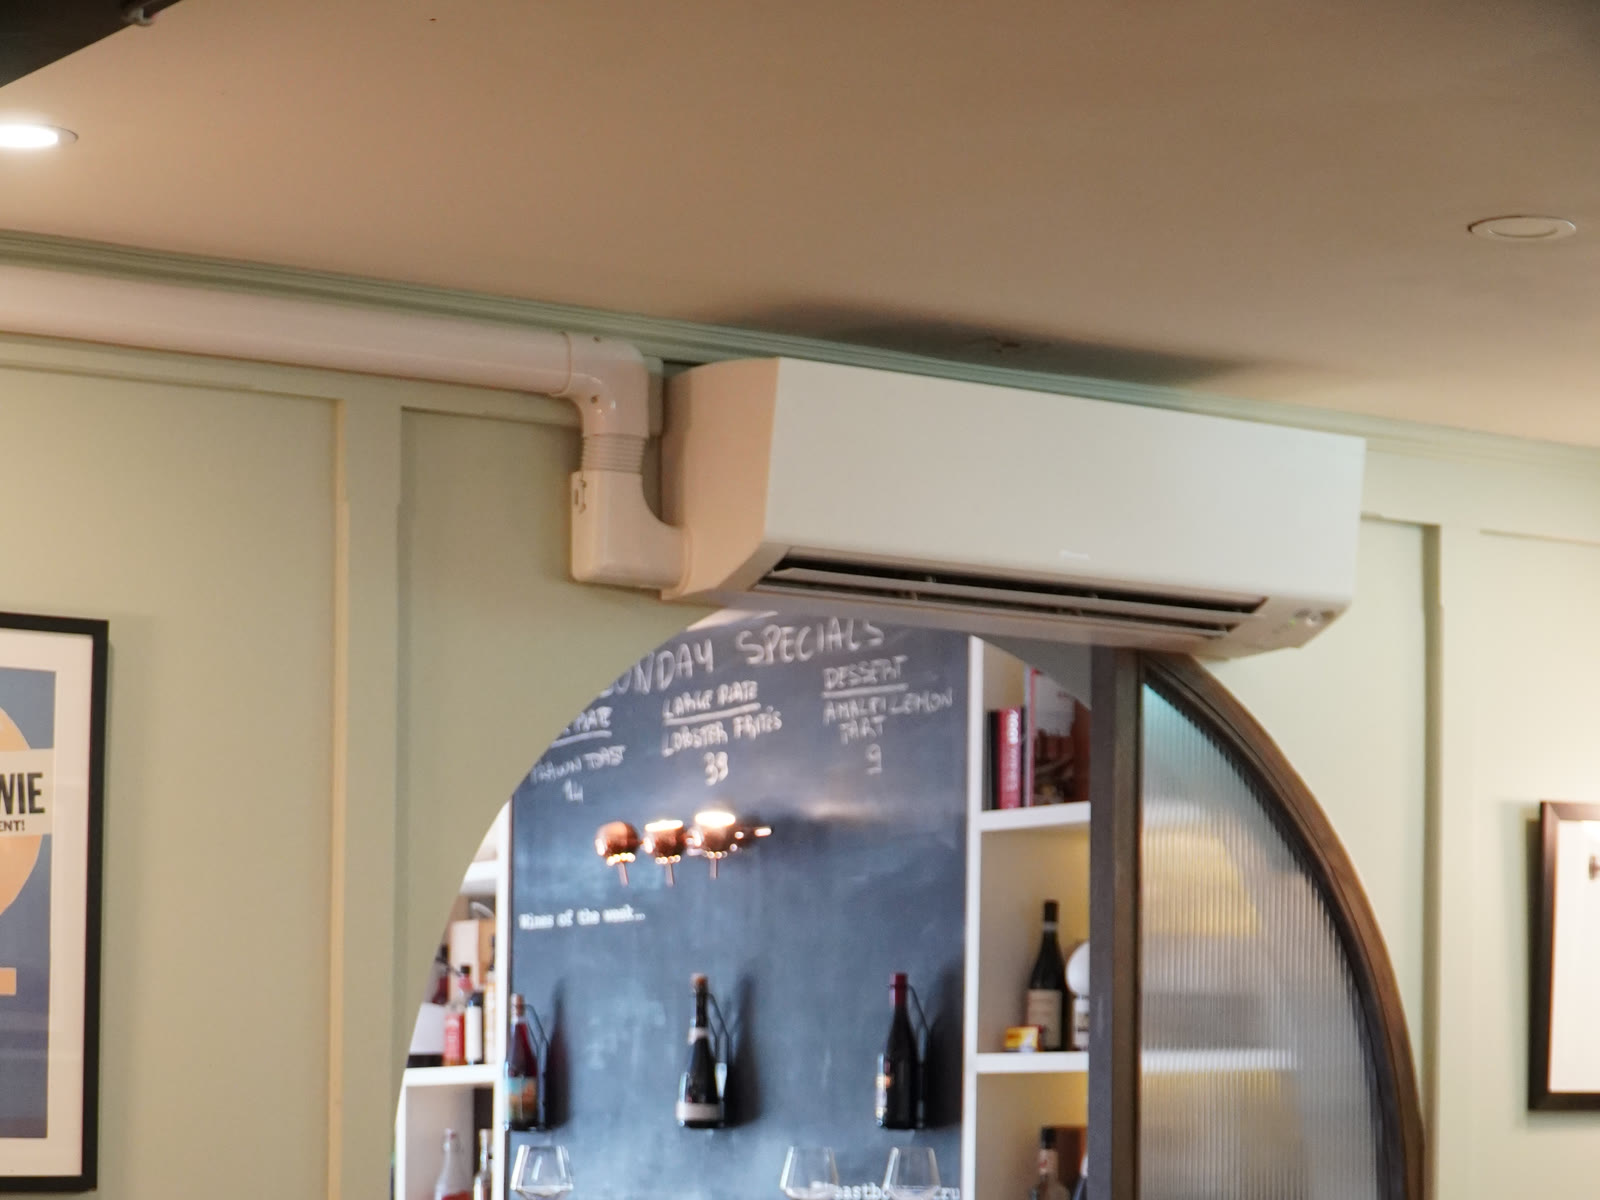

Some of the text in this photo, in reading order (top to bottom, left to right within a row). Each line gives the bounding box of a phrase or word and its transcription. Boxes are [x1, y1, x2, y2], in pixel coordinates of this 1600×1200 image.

[600, 617, 885, 697] UNDAY SPECIALS
[823, 655, 908, 690] DESSERT
[888, 687, 953, 714] LEMON
[661, 721, 729, 758] LOBSTER
[839, 715, 887, 745] TART
[556, 909, 574, 928] of
[576, 908, 600, 926] the
